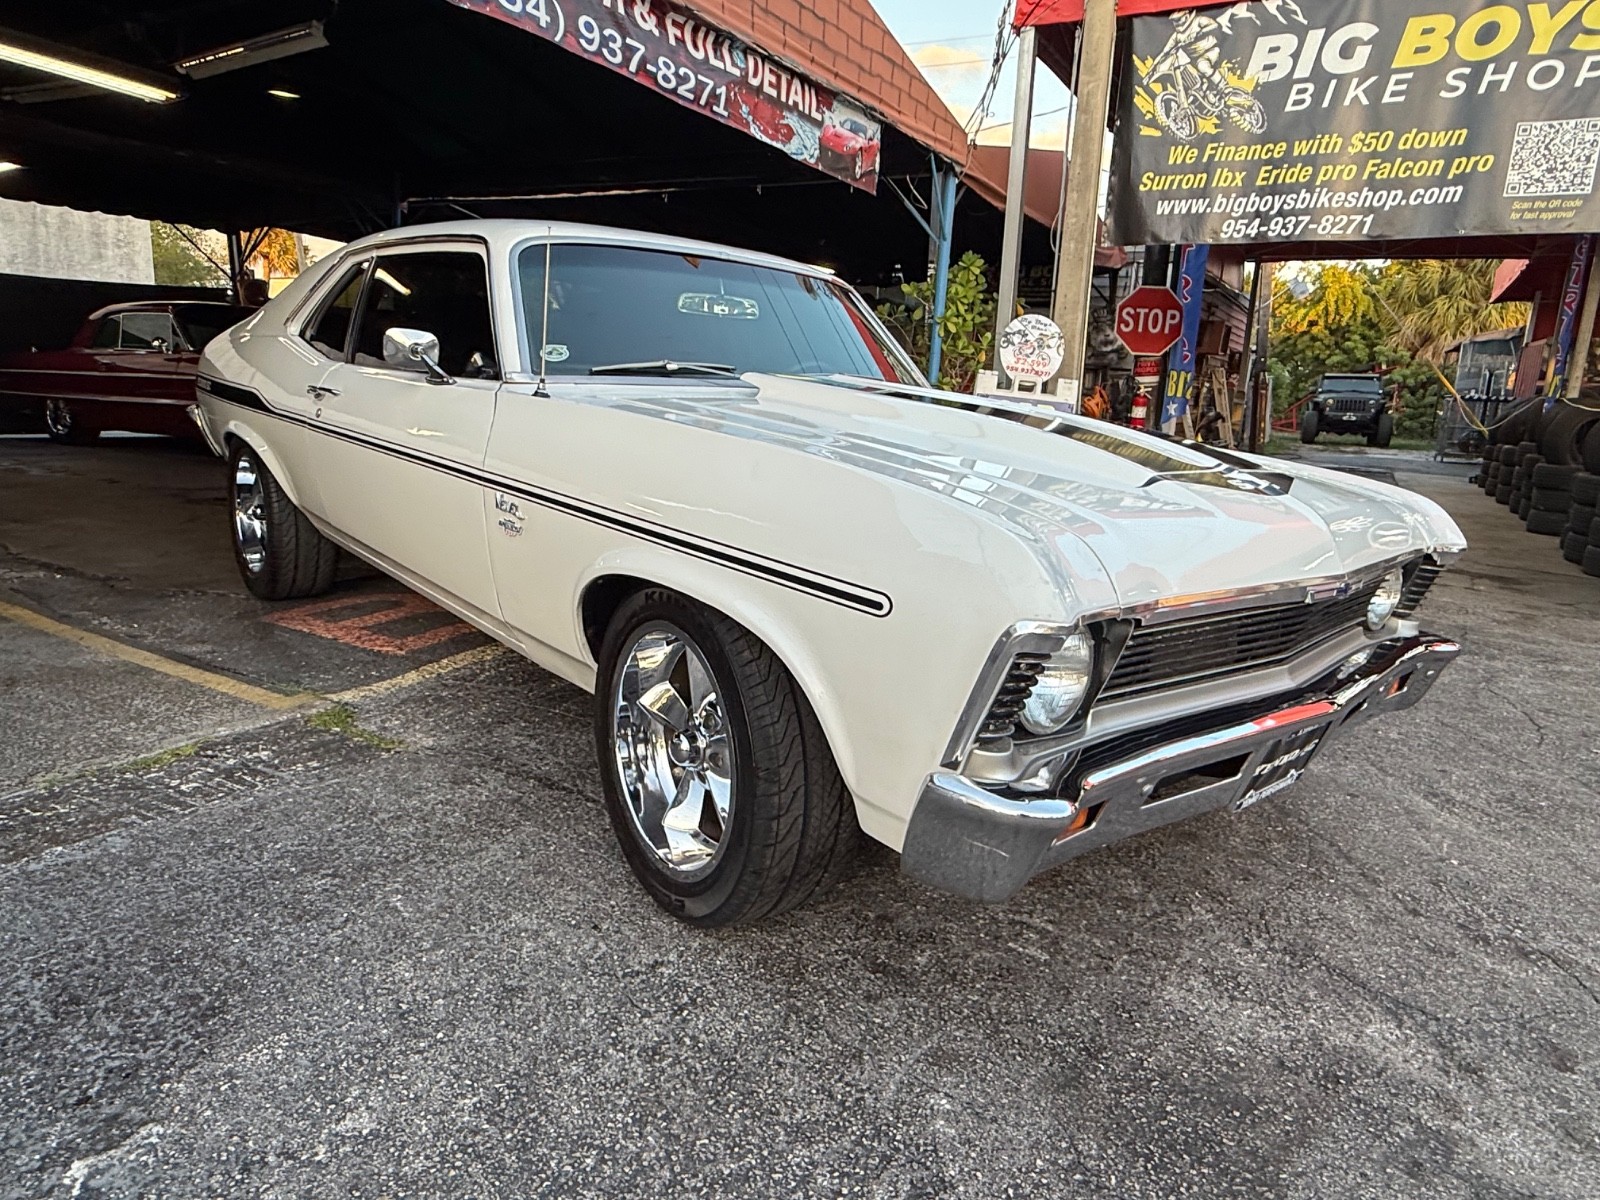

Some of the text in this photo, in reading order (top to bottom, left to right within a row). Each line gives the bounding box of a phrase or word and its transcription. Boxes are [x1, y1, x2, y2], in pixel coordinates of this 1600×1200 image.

[577, 14, 729, 117] 937-8271
[665, 12, 741, 78] FULL
[747, 53, 823, 121] DETAIL
[1244, 22, 1379, 84] BIG
[1284, 55, 1600, 112] BIKE SHOP
[1168, 128, 1468, 165] We Finance with $50 down
[1139, 171, 1208, 192] Surron
[1255, 163, 1313, 187] Eride
[1315, 163, 1358, 185] pro
[1362, 157, 1445, 180] Falcon
[1447, 154, 1495, 179] pro
[1156, 185, 1463, 217] www.bigboysbikeshop.com
[1509, 211, 1521, 220] for
[1539, 209, 1576, 220] approval
[1511, 198, 1583, 209] Scan the QR code
[1220, 213, 1374, 238] 954-937-8271
[1119, 306, 1180, 334] STOP
